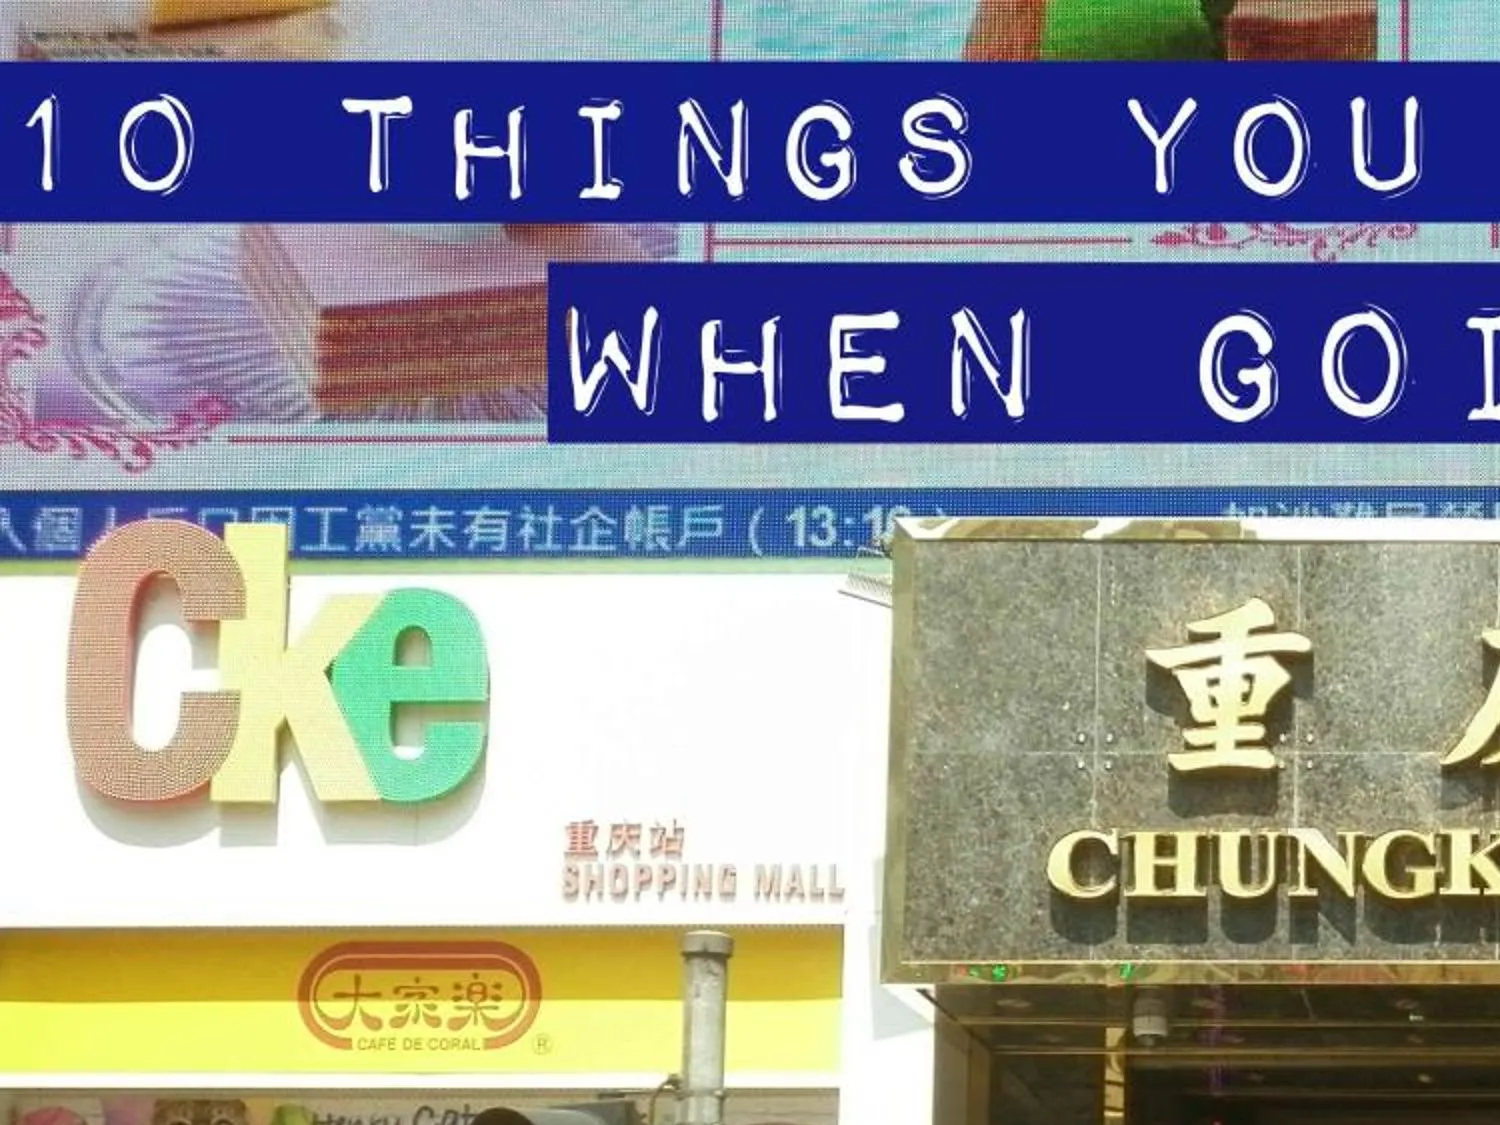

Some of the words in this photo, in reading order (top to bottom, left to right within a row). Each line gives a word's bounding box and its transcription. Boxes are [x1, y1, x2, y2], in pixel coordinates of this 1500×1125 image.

[561, 863, 738, 903] SHOPPING
[754, 863, 846, 903] MALL
[402, 1037, 423, 1051] DE
[426, 1037, 481, 1051] CORAL
